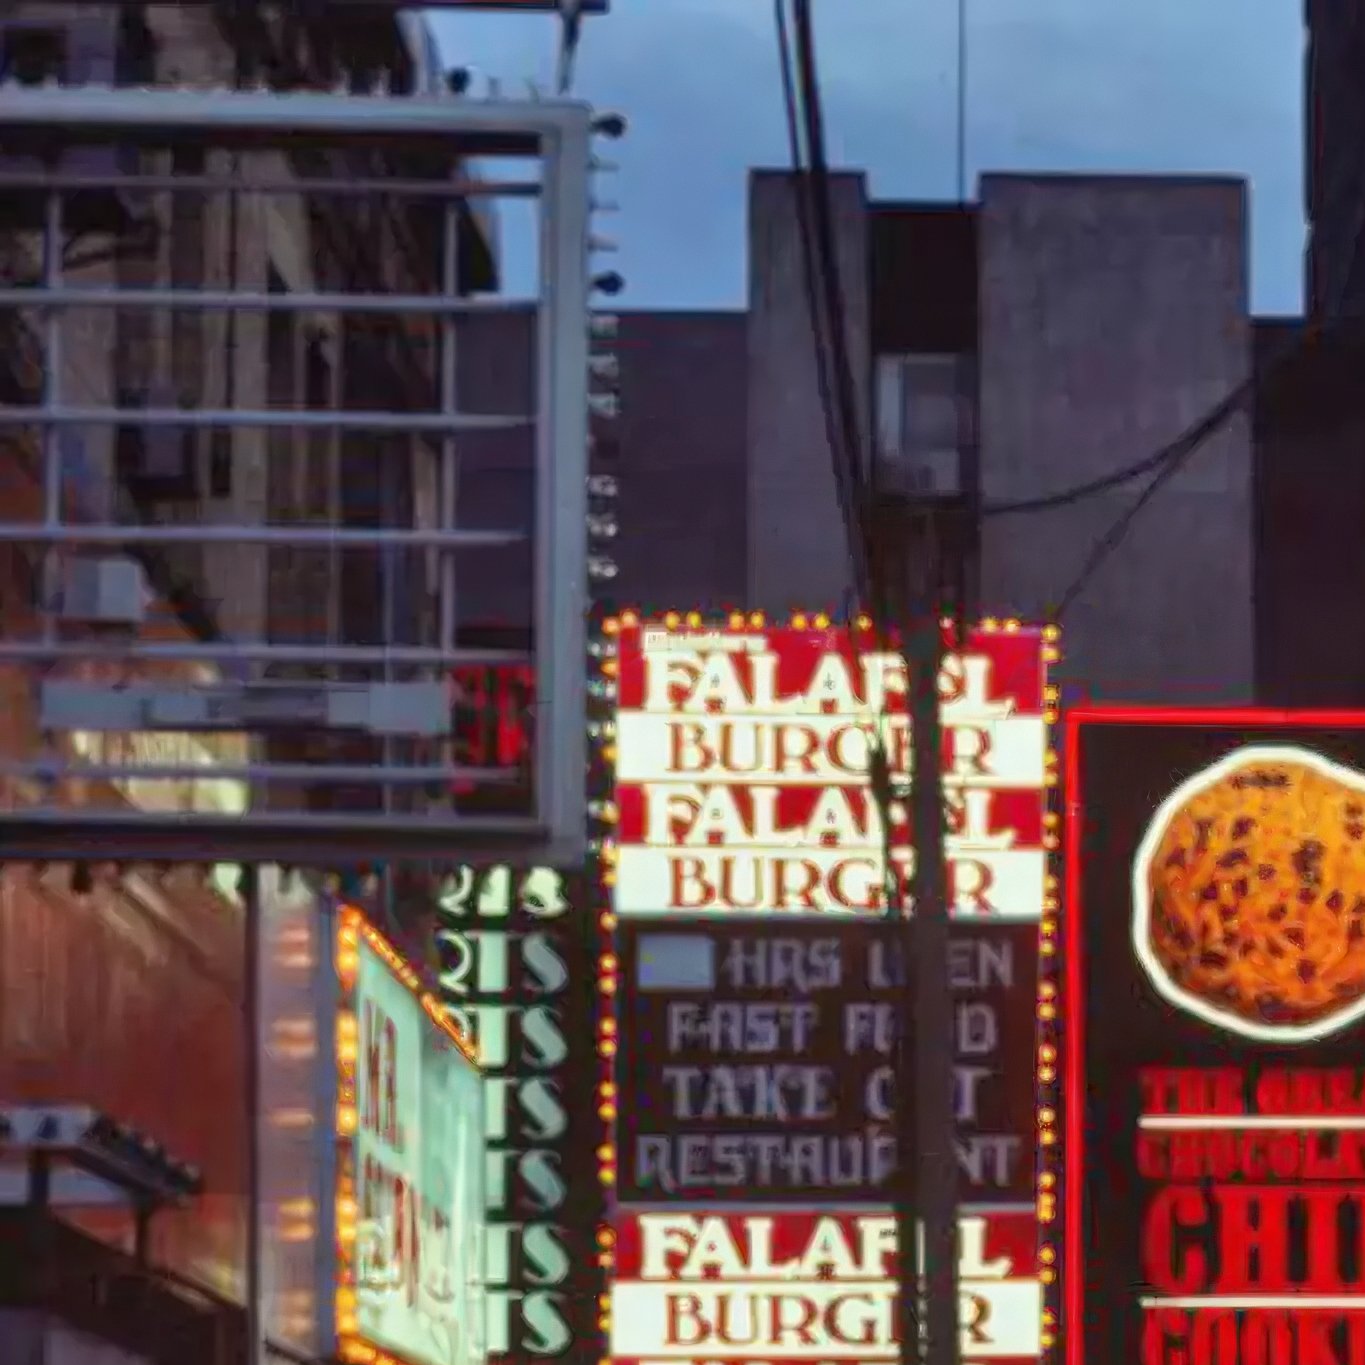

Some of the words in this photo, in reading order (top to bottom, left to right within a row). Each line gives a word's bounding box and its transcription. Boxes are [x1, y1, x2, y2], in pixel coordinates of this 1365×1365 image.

[869, 938, 1014, 988] OEN
[668, 1001, 818, 1053] FAST
[845, 1002, 998, 1054] FOD
[663, 1066, 838, 1120] TAKE
[865, 1066, 992, 1121] OT
[1140, 1068, 1243, 1114] THE
[635, 1135, 1019, 1191] RESTAURNT
[639, 1215, 1014, 1280] FALAFL
[664, 1292, 992, 1346] BURGR
